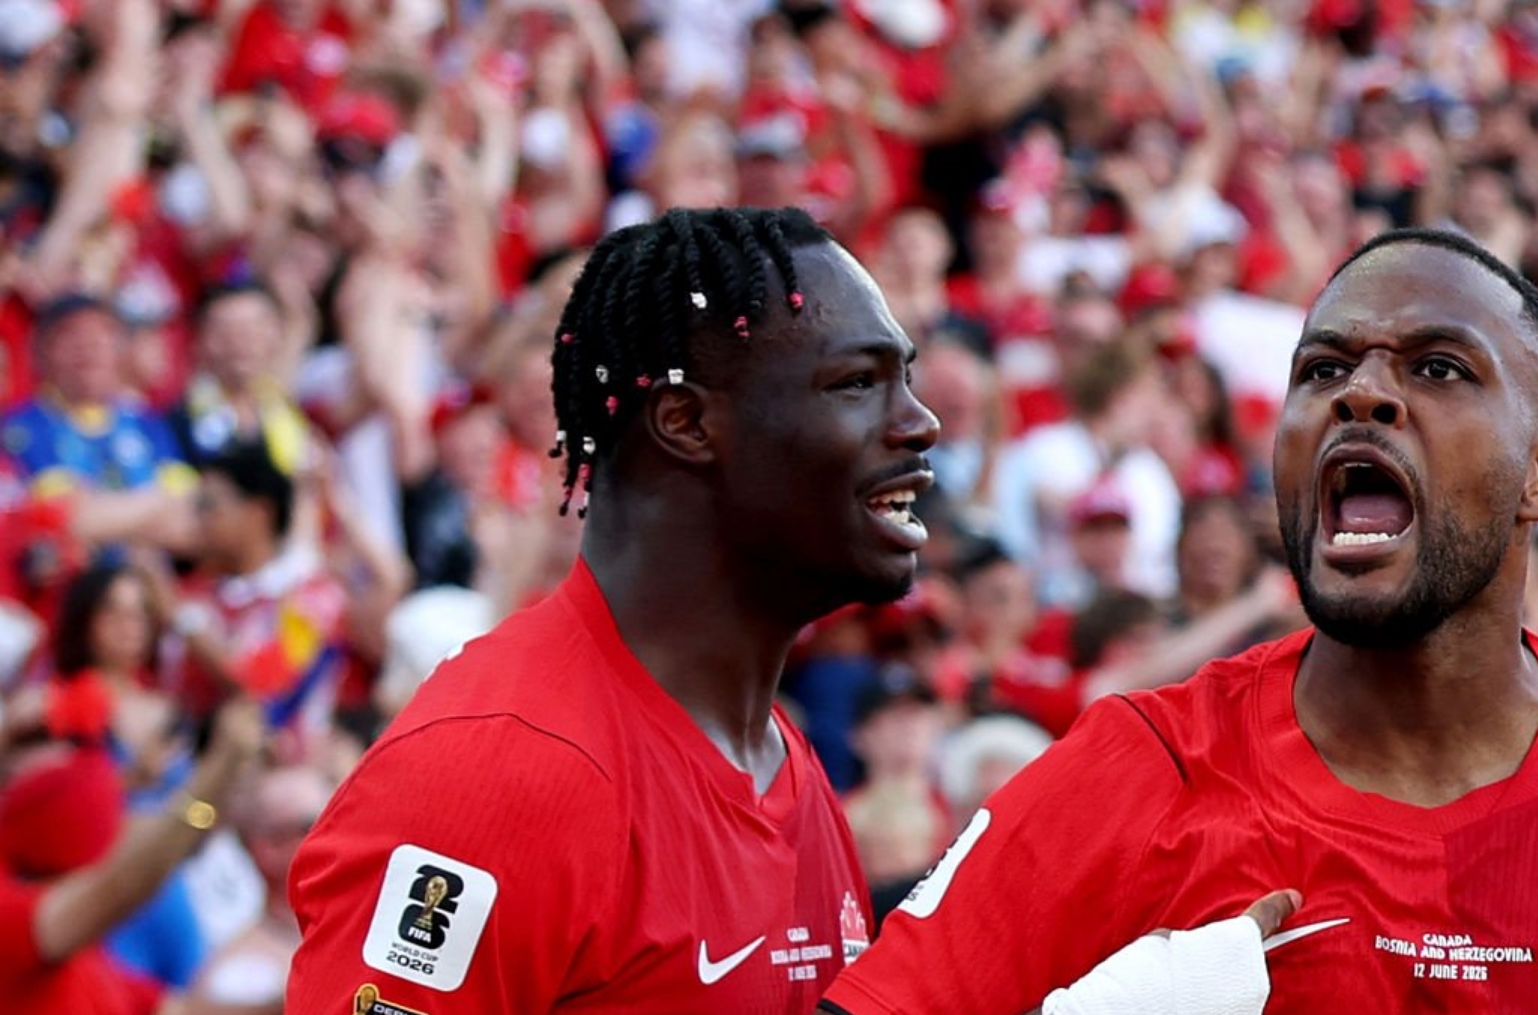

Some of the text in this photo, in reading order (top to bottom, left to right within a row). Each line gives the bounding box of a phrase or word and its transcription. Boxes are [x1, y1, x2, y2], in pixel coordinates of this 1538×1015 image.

[407, 926, 432, 943] FIFA
[1422, 933, 1472, 947] CANADA
[392, 942, 438, 962] WORLD CUP
[1375, 935, 1533, 962] BOSNIA AND HERZEGOVINA
[386, 950, 436, 975] 2026
[1413, 963, 1488, 980] 12 JUNE 2026
